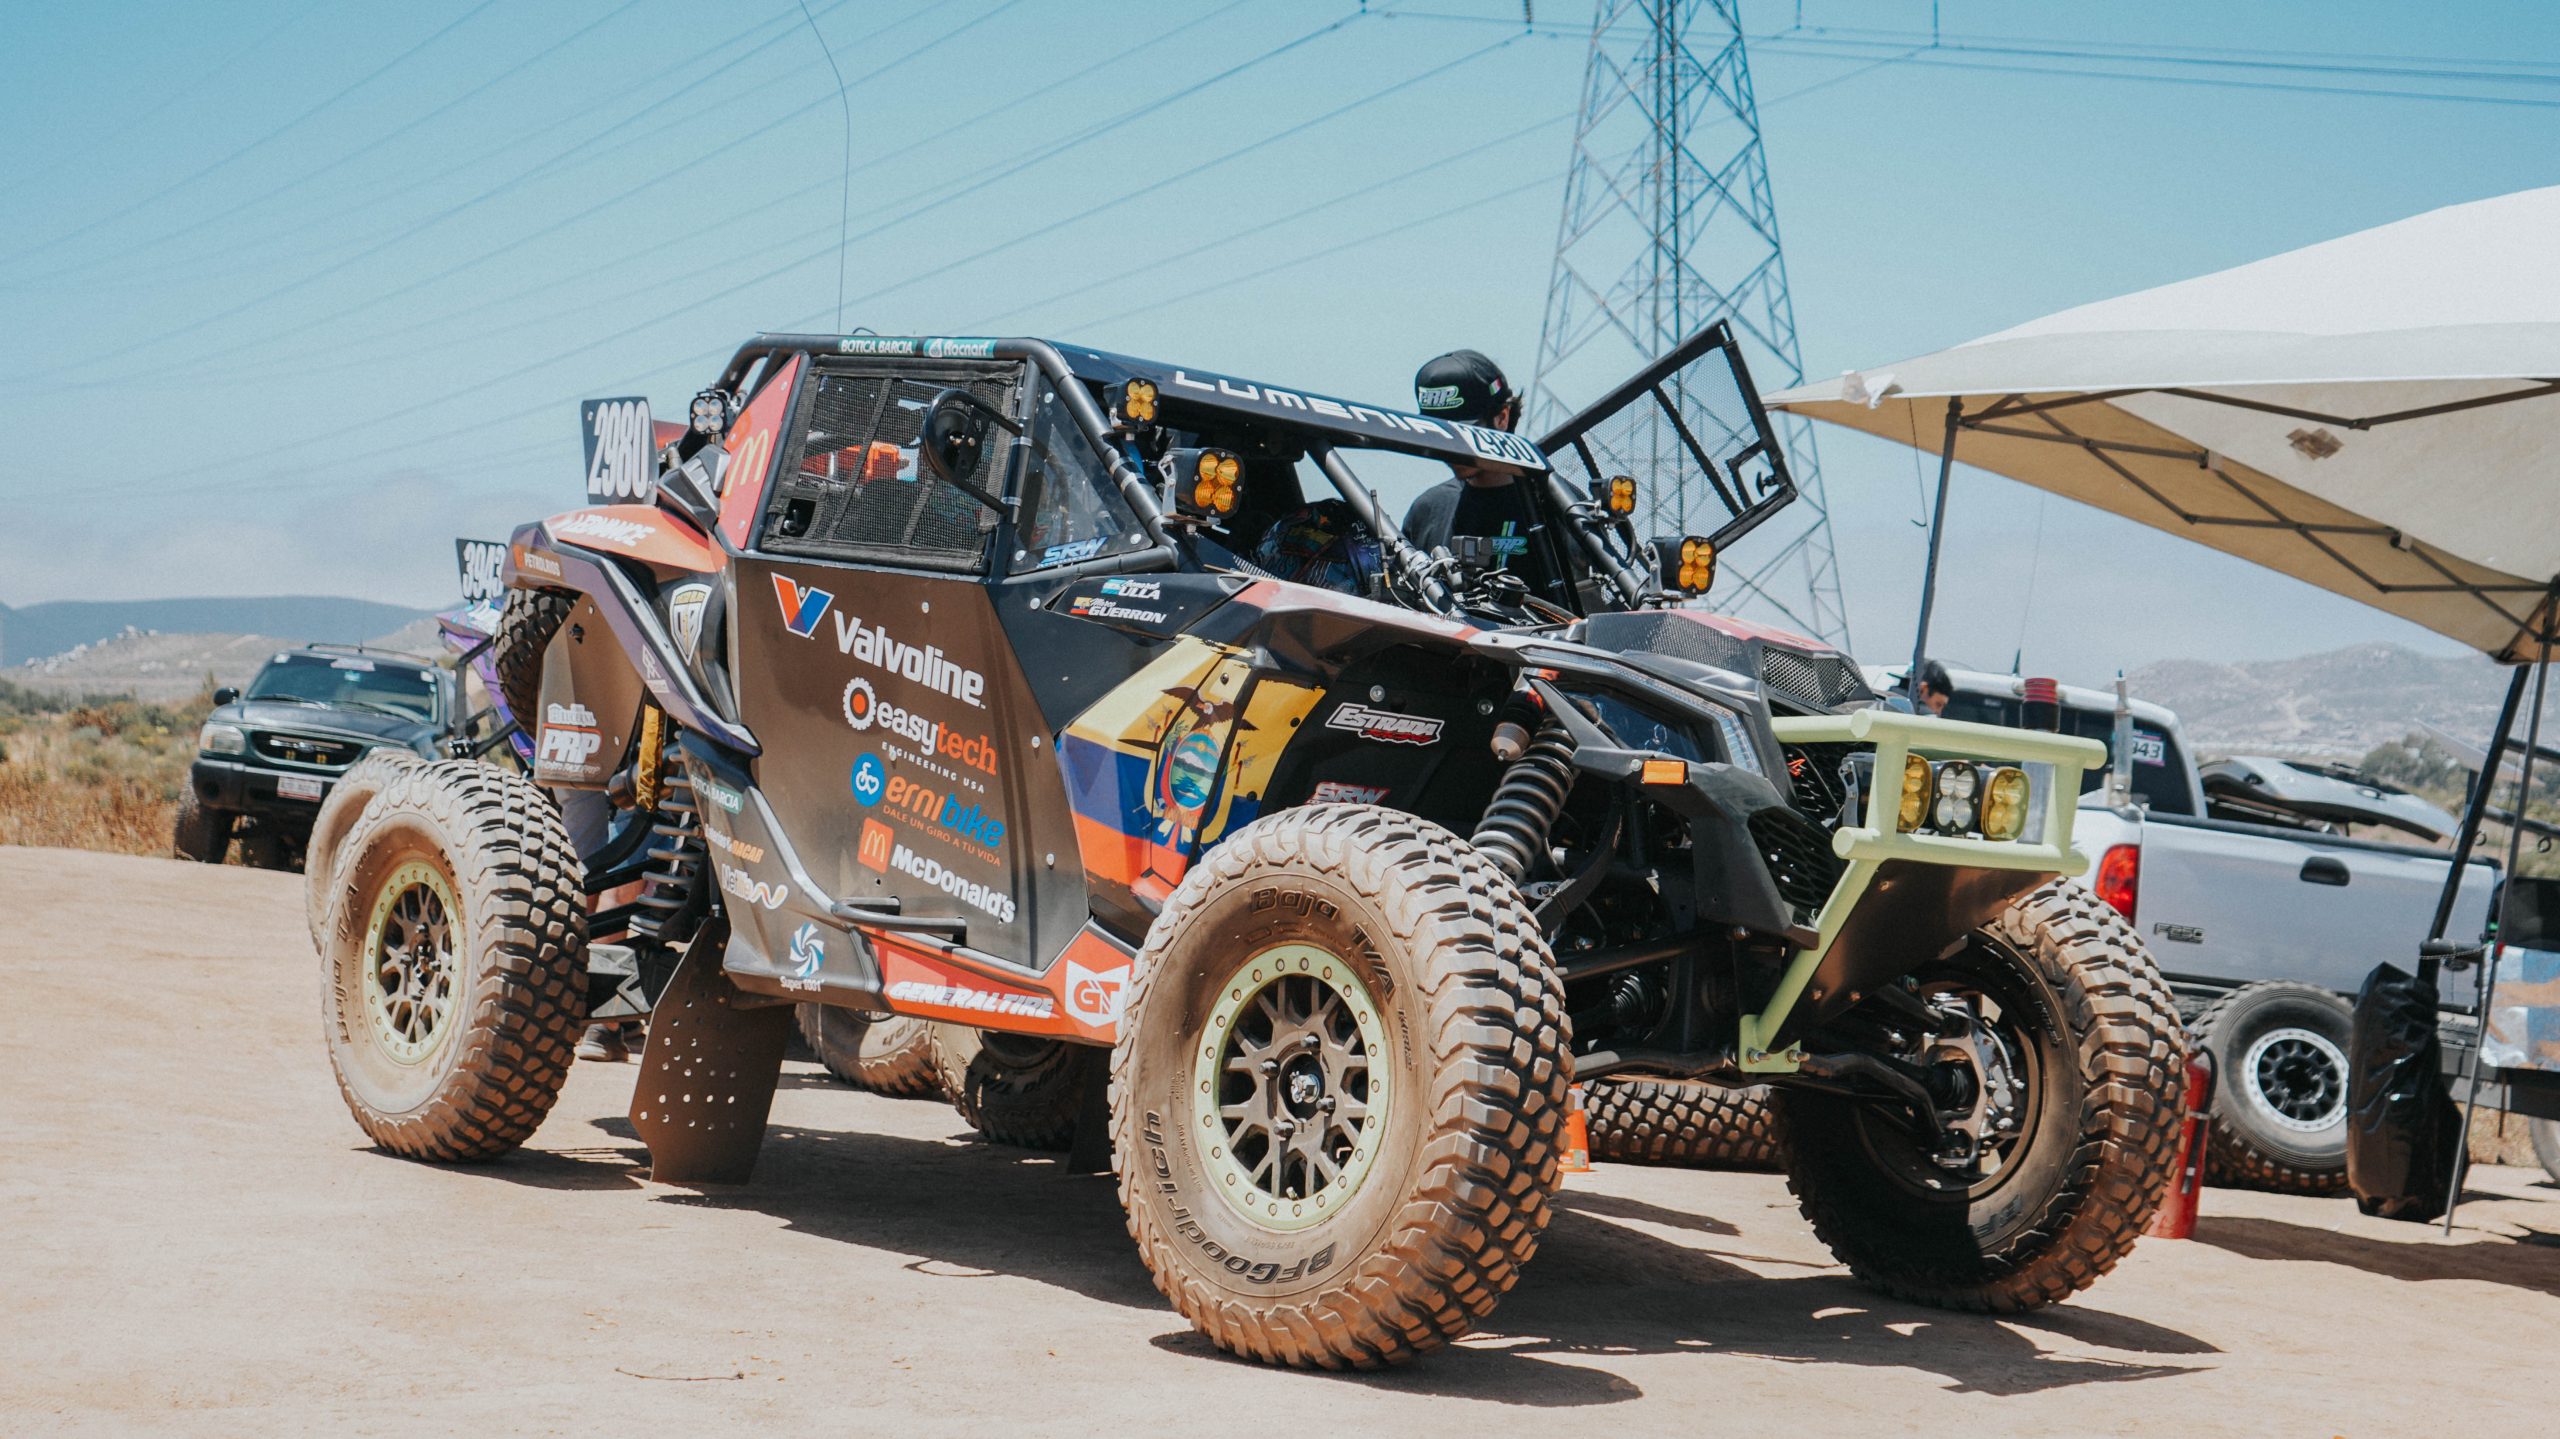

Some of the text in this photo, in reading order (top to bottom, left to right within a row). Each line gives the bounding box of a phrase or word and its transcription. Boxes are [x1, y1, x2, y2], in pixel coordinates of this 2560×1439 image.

[841, 339, 913, 354] BOTICA BARCIA
[1173, 370, 1454, 439] LUMENIA
[588, 400, 650, 498] 2980
[1458, 423, 1537, 464] 2980
[1042, 536, 1107, 562] SRW
[1088, 606, 1168, 624] GUERRON
[1118, 585, 1161, 600] ULLA
[834, 609, 985, 708] Valvoline
[540, 729, 601, 764] PRP
[877, 702, 997, 776] easytech
[881, 741, 985, 794] ENGINEERING USA
[710, 783, 740, 811] BARCIA
[885, 775, 1006, 848] ernibike
[883, 804, 1001, 867] DALE UN GIRO A TU VIDA
[891, 844, 1016, 923] McDonald's
[1250, 885, 1340, 921] Baja
[1144, 1111, 1336, 1285] BFGoodrich
